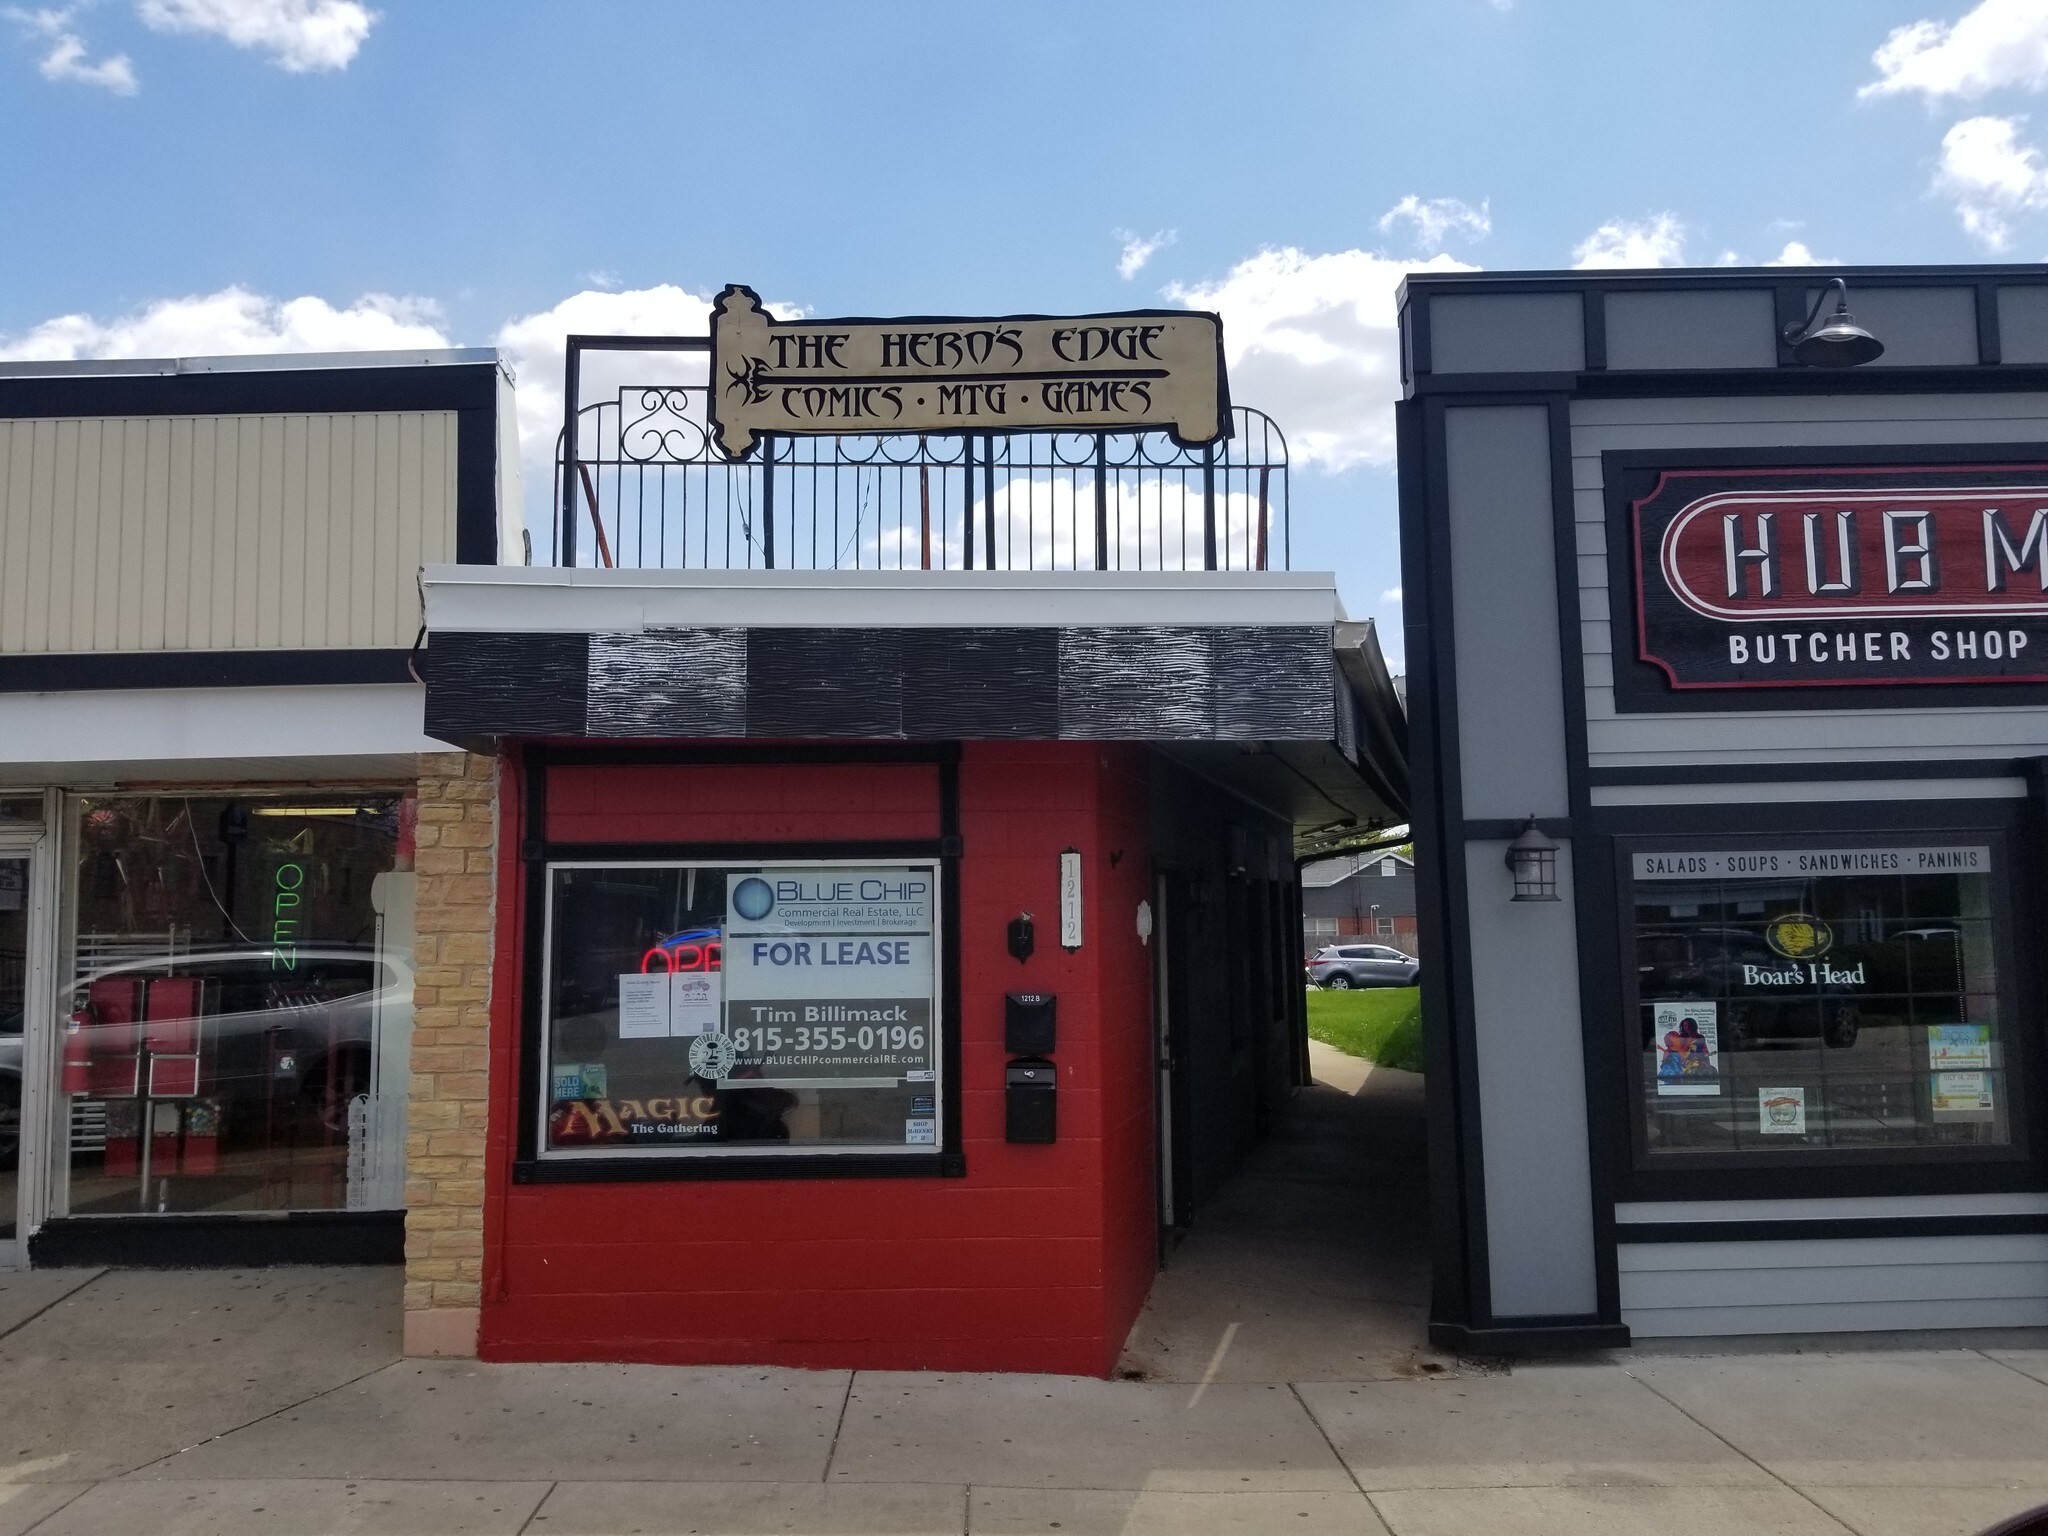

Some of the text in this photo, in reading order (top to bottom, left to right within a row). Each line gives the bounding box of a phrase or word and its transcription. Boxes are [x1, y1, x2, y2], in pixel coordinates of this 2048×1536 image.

[769, 325, 1165, 369] THE HERO'S EDGE
[781, 380, 1152, 419] COMICS MTG GAMES
[1723, 509, 1937, 599] HUB
[1729, 630, 2028, 664] BUTCHER SHOP
[1646, 851, 1978, 874] SALADS SOUPS SANDWICHES PANINIS
[777, 880, 926, 901] BLUE CHIP
[272, 863, 303, 971] OPEN
[777, 906, 924, 918] Commercial Real Estate, LLC
[784, 918, 917, 928] Development Investment Brokerage
[753, 941, 910, 966] FOR LEASE
[1742, 962, 1866, 985] Boar's Head
[751, 1005, 907, 1022] Tim Billimack
[734, 1026, 924, 1051] 815-355-0196
[734, 1054, 924, 1066] www.BLUECHIPcommercialRE.com
[554, 1076, 580, 1088] SOLD
[554, 1087, 580, 1098] HERE
[631, 1123, 719, 1135] The Gathering
